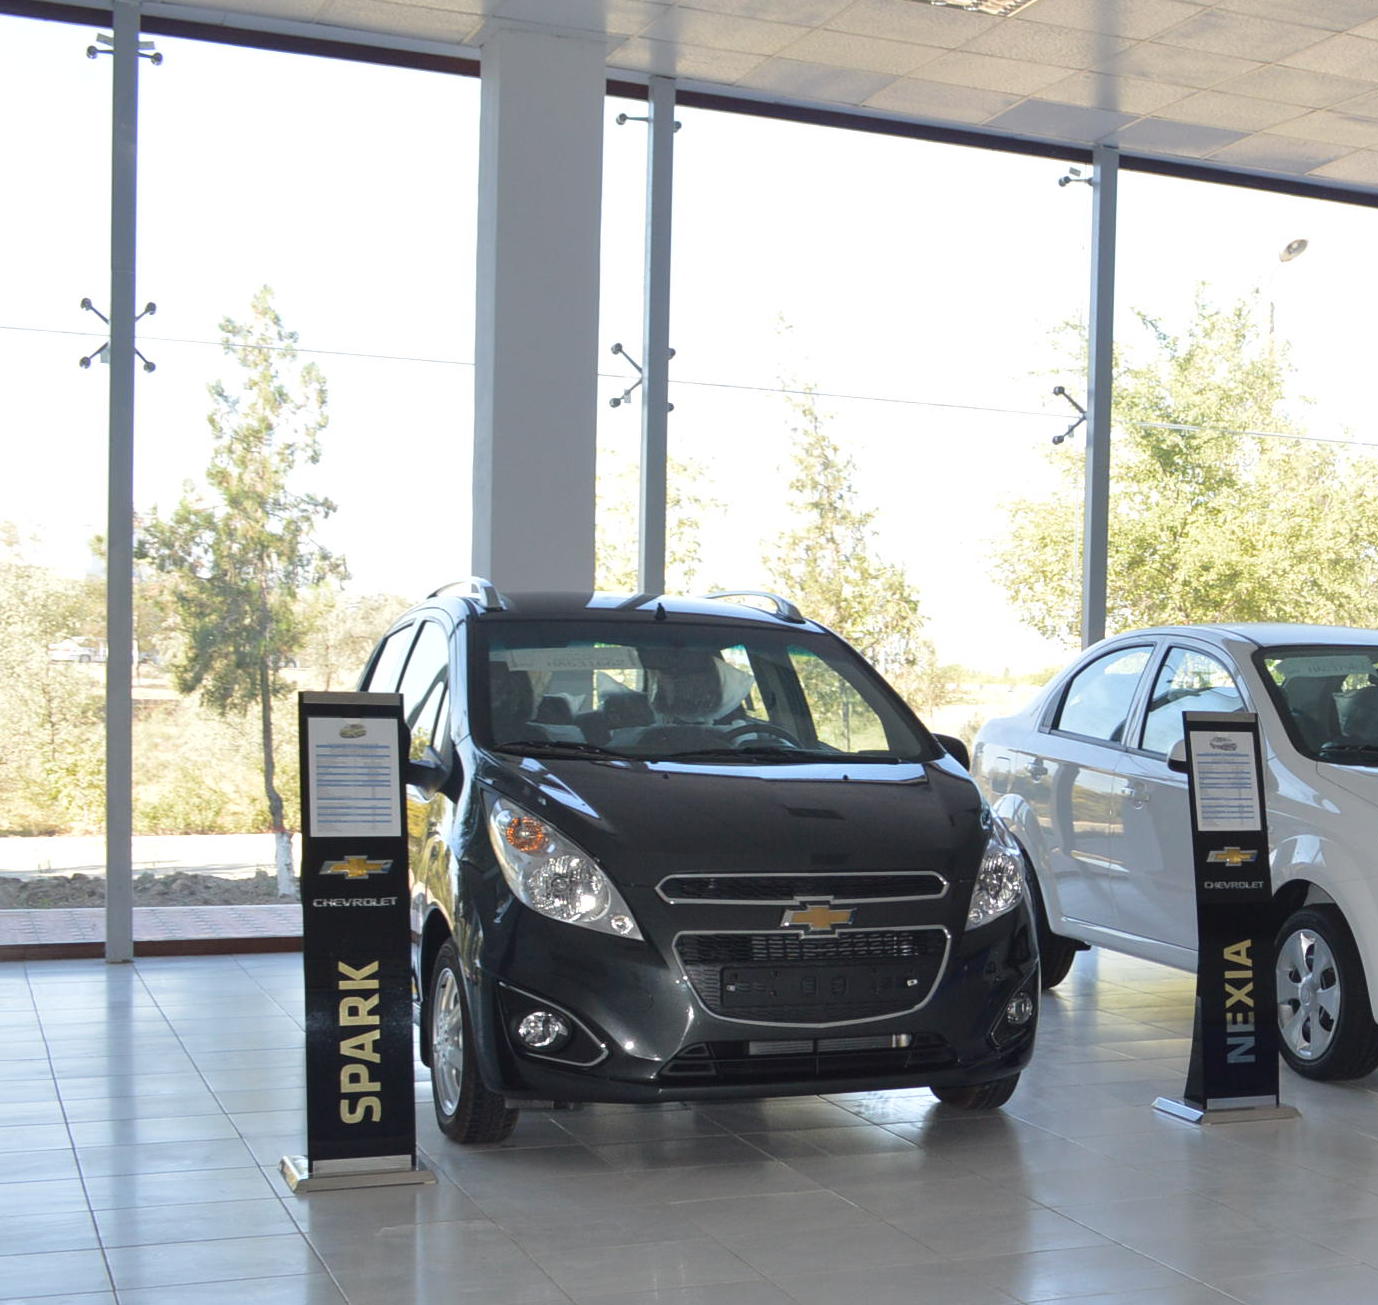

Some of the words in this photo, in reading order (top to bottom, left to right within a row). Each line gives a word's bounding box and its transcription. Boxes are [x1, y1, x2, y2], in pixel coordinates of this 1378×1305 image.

[313, 897, 398, 908] CHEVROLET
[1204, 881, 1264, 889] CHEVROLET
[1223, 938, 1257, 1064] NEXIA
[337, 960, 382, 1124] SPARK
